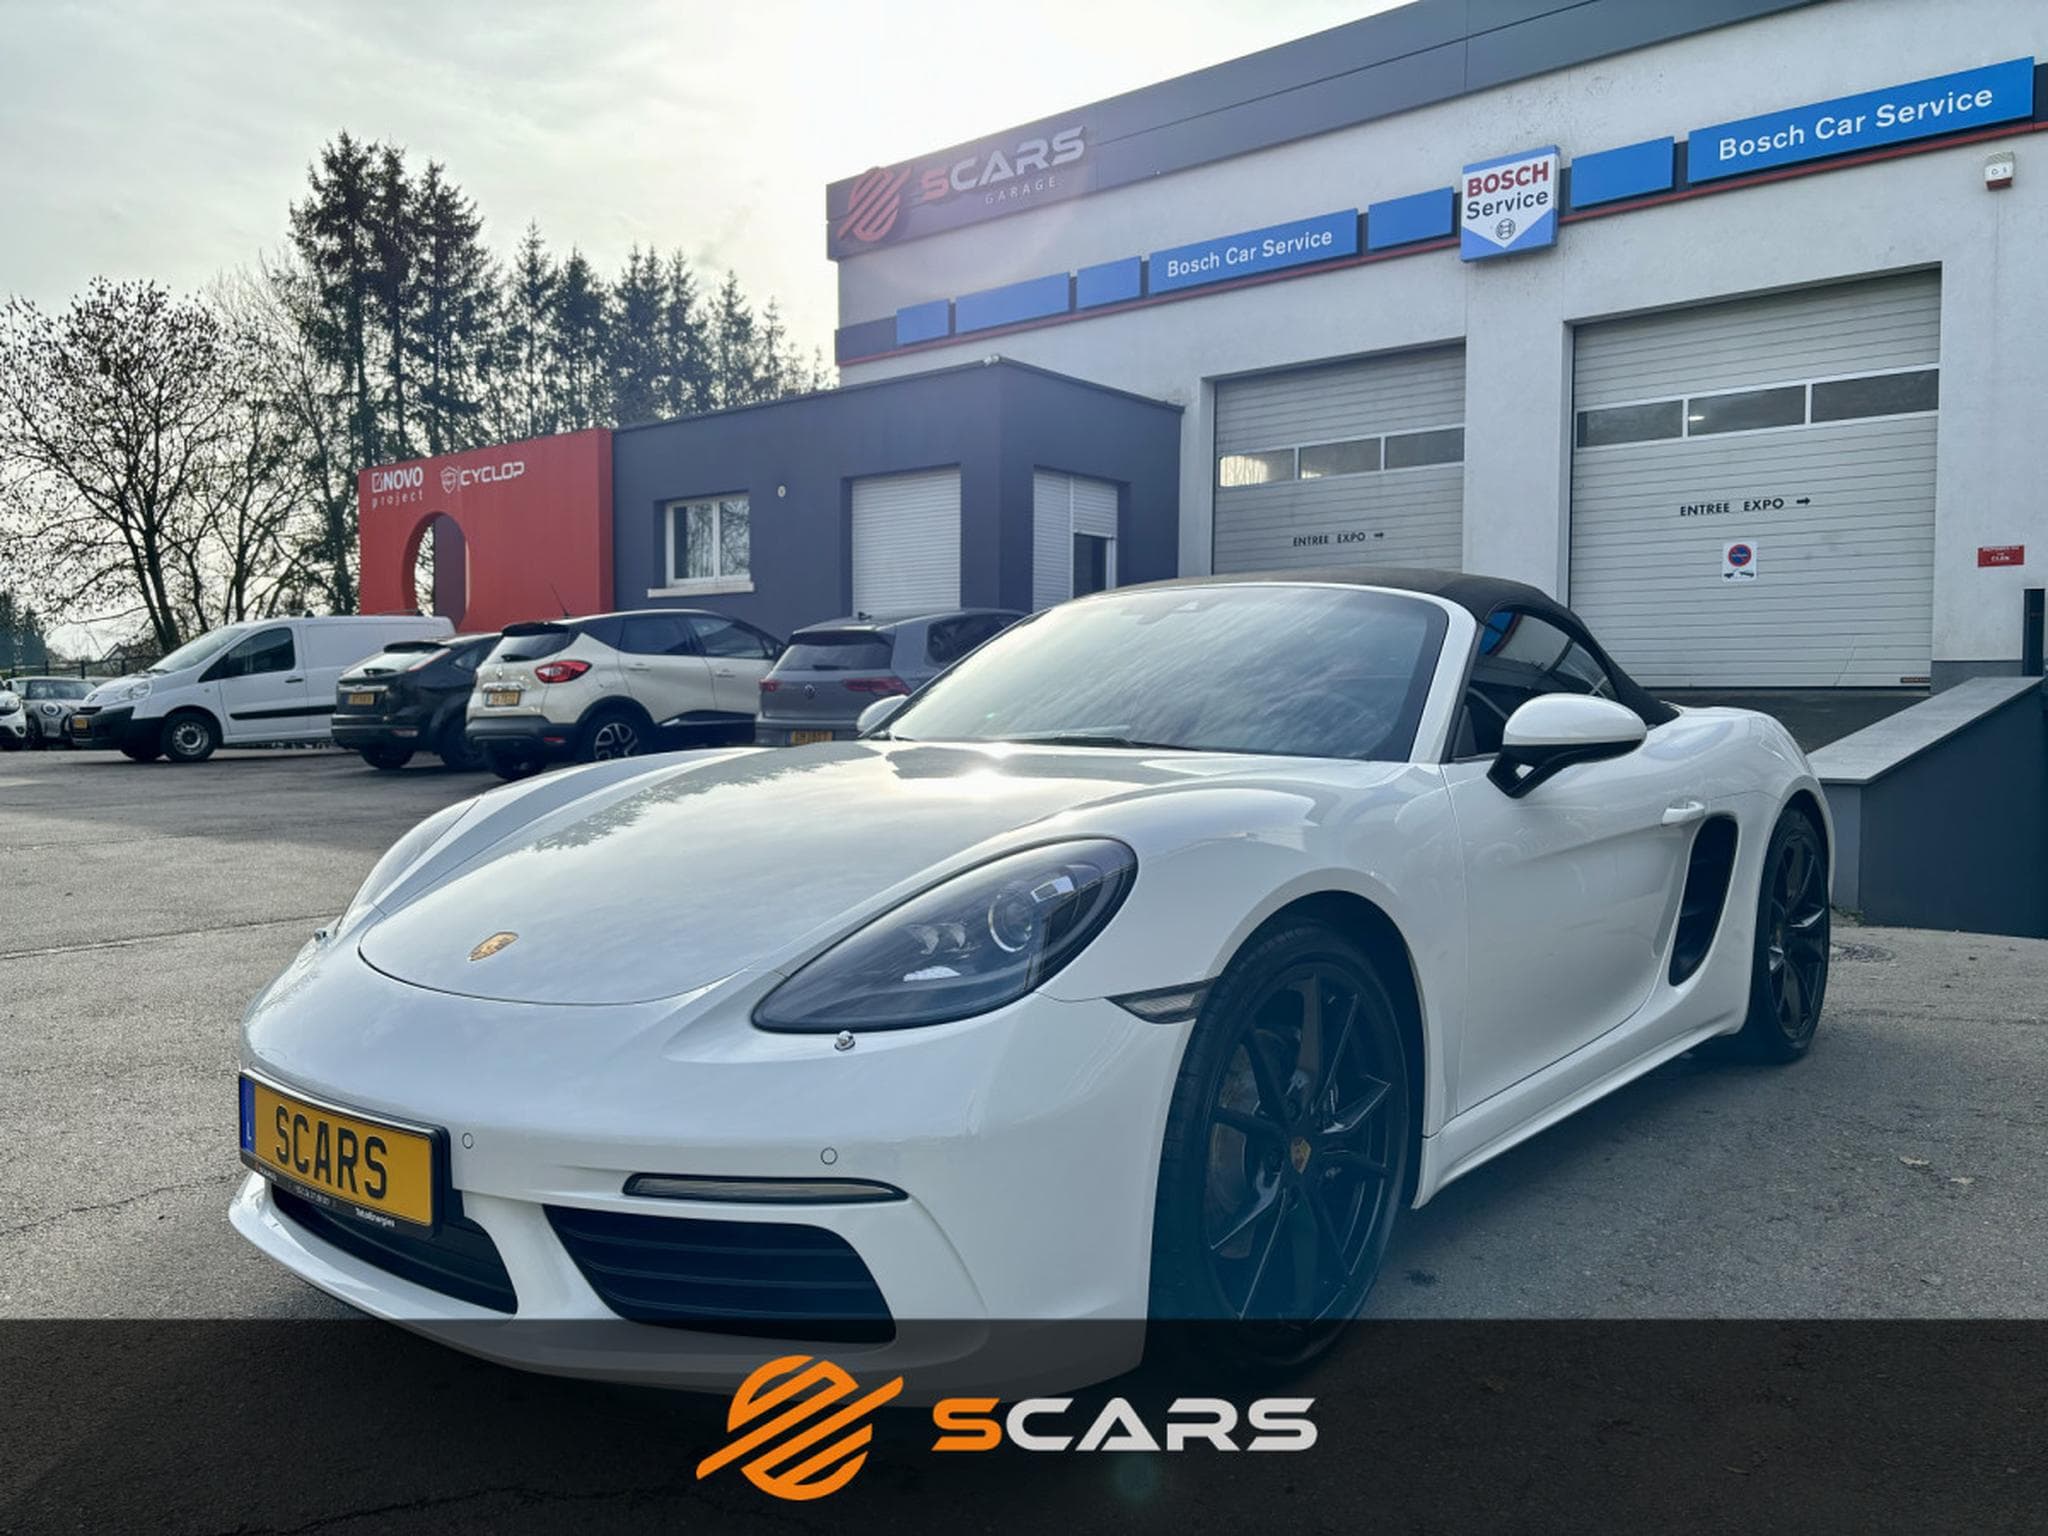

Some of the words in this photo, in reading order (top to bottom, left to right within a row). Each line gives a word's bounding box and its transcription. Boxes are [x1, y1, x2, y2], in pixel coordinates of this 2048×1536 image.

[1719, 124, 1805, 161] Bosch
[1815, 115, 1867, 140] Car
[1875, 88, 1993, 128] Service
[920, 125, 1086, 202] SCARS
[985, 175, 1056, 205] GARAGE
[1467, 161, 1549, 198] BOSCH
[1466, 190, 1549, 220] Service
[1167, 252, 1220, 277] Bosch
[1225, 246, 1258, 265] Car
[1262, 231, 1333, 258] Service
[460, 461, 525, 486] CYCLOP
[371, 490, 423, 509] project
[1680, 502, 1730, 517] ENTREE
[1743, 497, 1785, 512] EXPO
[1292, 534, 1330, 547] ENTREE
[1337, 531, 1366, 544] EXPO
[275, 1103, 388, 1200] SCARS
